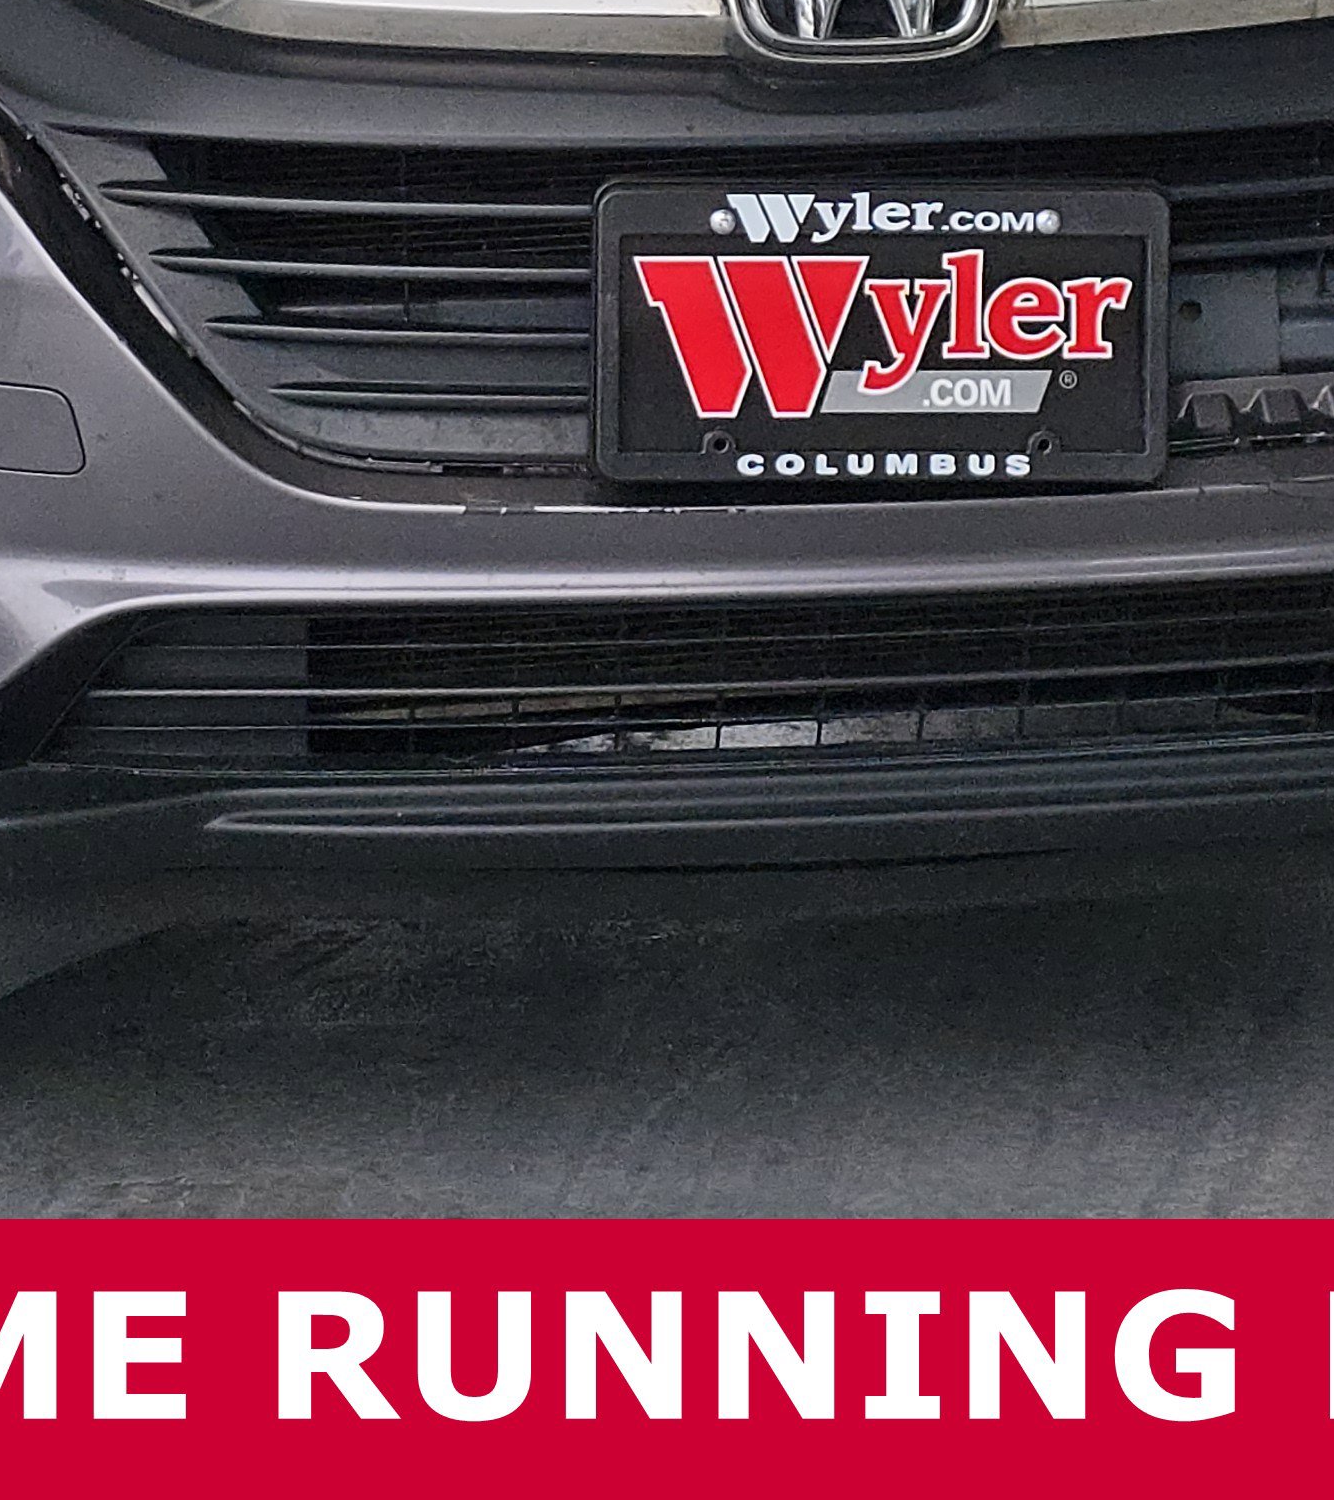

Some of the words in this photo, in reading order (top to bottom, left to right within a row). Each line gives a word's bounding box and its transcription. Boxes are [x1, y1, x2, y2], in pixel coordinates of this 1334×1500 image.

[632, 248, 1134, 419] Wyler
[922, 378, 1012, 408] .COM
[735, 452, 1033, 477] COLUMBUS
